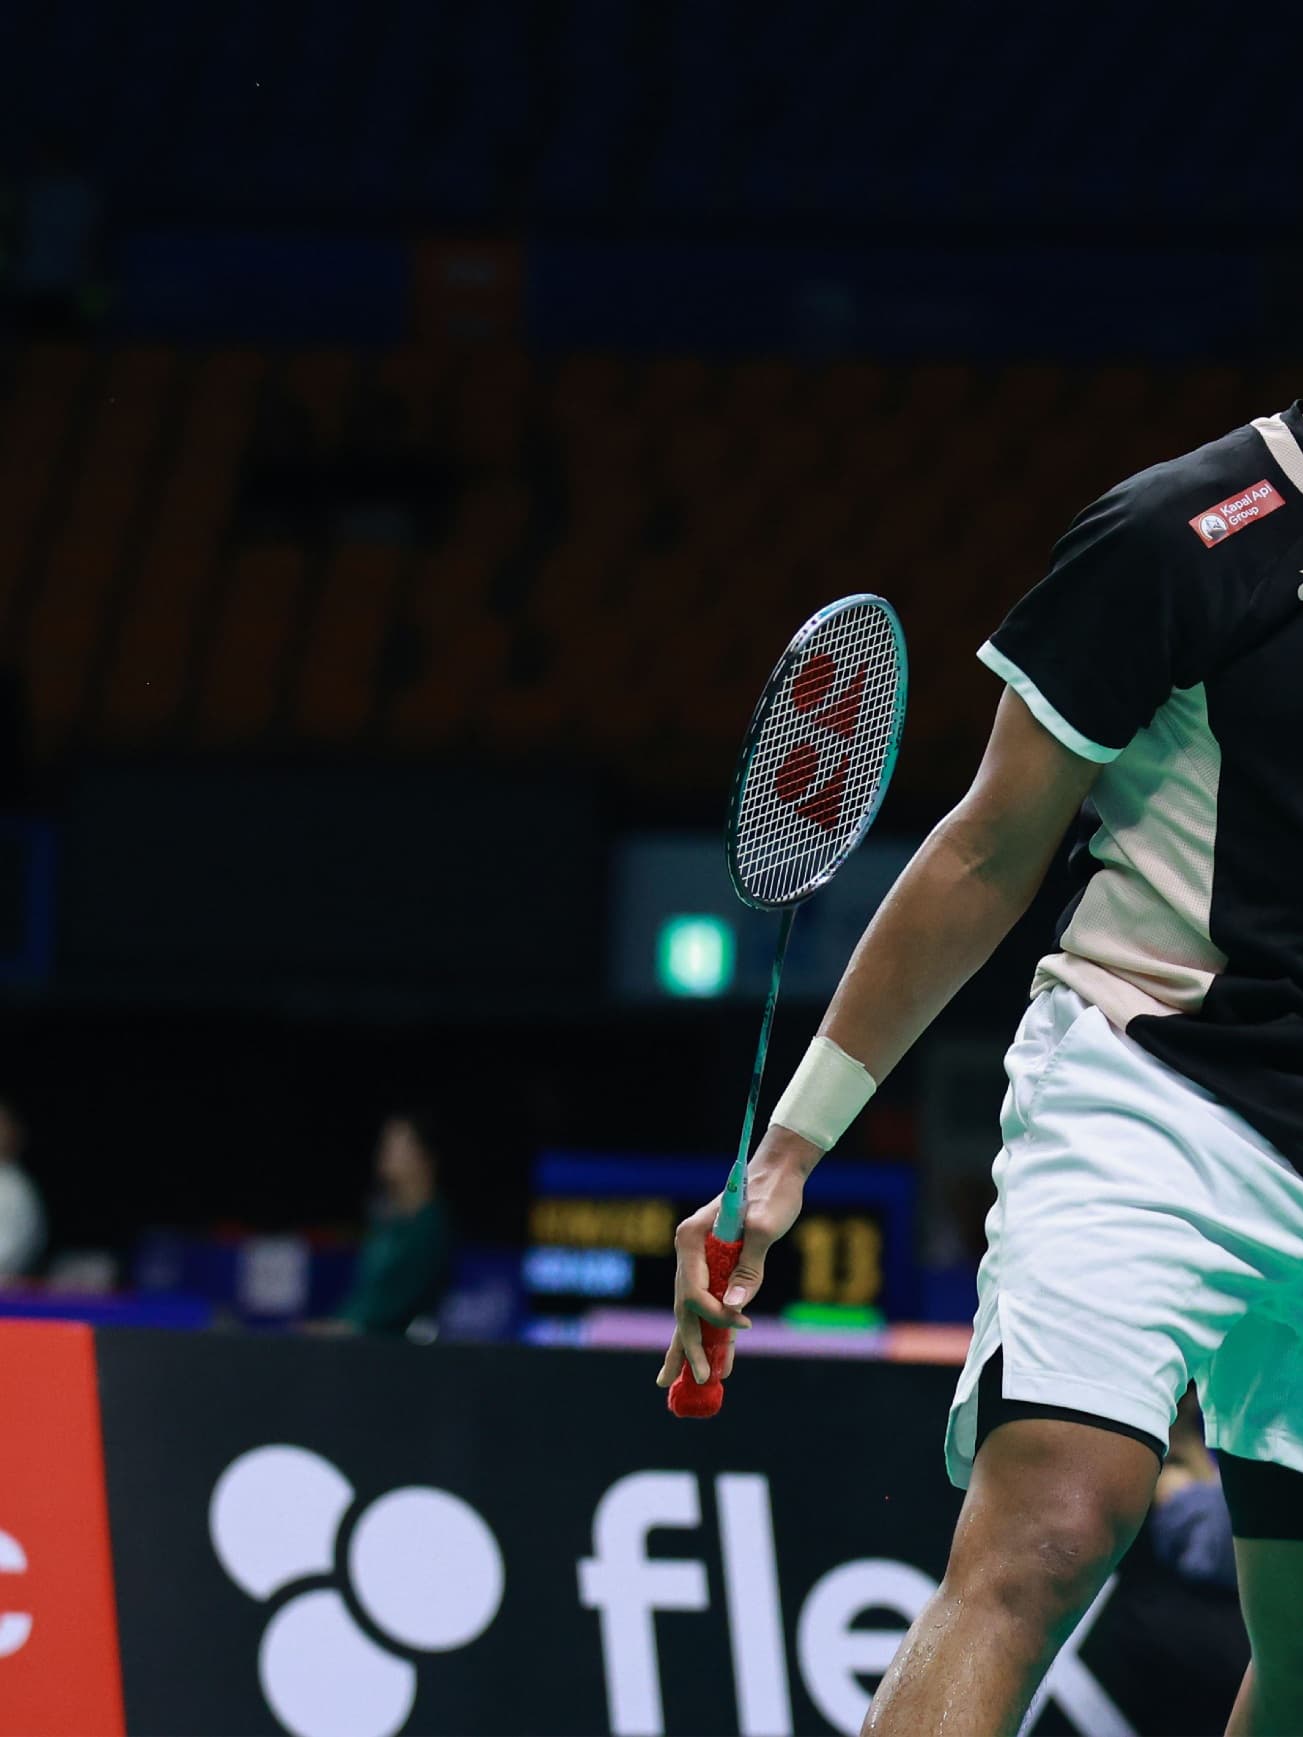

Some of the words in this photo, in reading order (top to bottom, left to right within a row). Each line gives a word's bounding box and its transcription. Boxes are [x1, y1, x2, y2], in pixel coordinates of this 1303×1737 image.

[1220, 494, 1253, 517] Kapal
[1251, 484, 1273, 502] Api
[1229, 506, 1260, 526] Group
